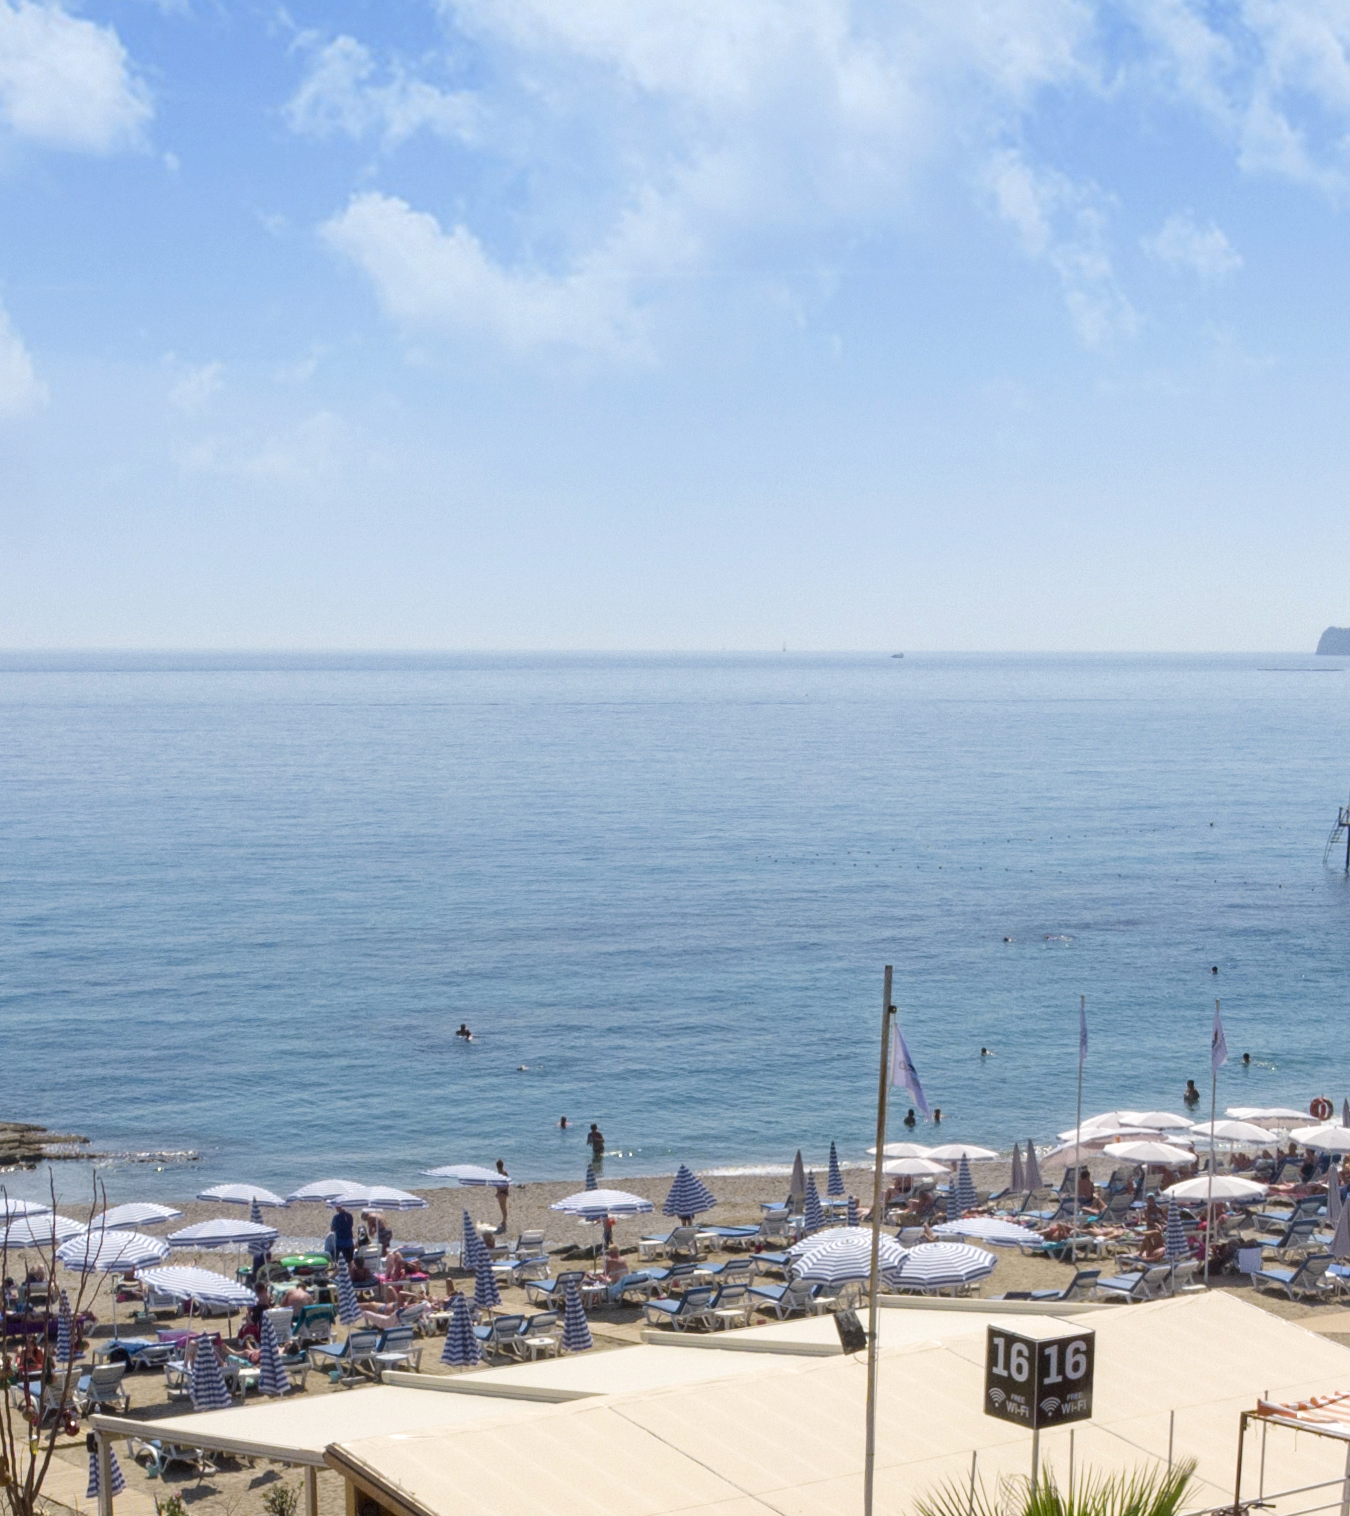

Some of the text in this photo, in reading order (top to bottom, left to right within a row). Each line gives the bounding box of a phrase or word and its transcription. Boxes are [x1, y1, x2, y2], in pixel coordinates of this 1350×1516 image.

[992, 1337, 1029, 1382] 16
[1043, 1340, 1087, 1385] 16
[1011, 1393, 1025, 1404] FREE
[1067, 1391, 1084, 1401] FREE
[1006, 1400, 1029, 1418] Wi-Fi
[1061, 1399, 1087, 1415] Wi-Fi
